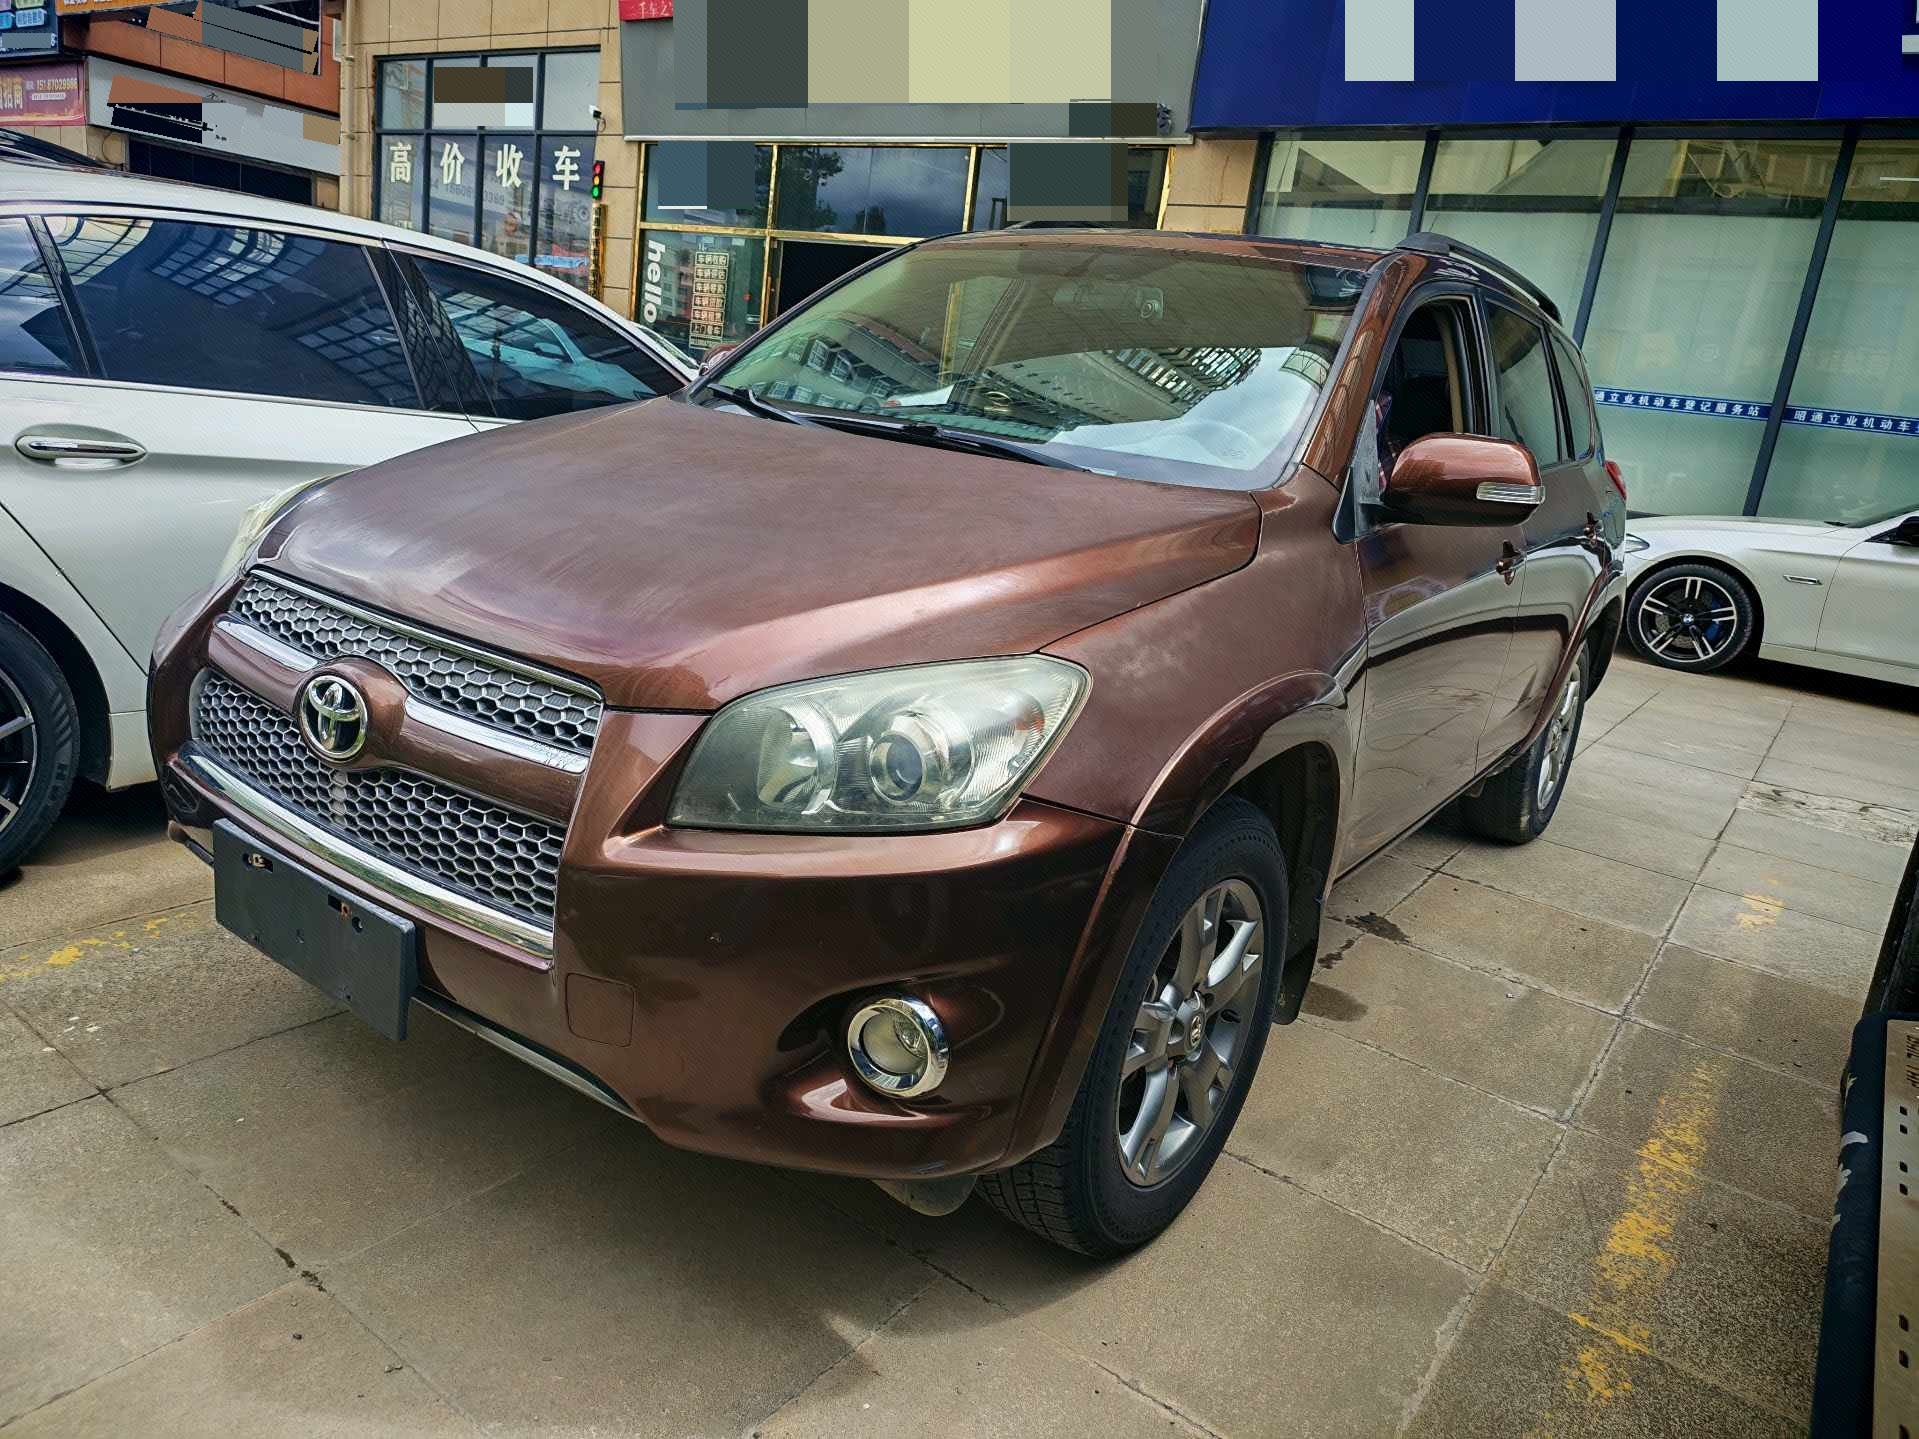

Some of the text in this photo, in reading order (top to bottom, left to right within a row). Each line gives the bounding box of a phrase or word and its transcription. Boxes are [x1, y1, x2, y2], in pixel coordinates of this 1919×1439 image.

[390, 142, 580, 191] 高价收车
[644, 240, 666, 323] hello
[1594, 390, 1760, 416] 通立业机动车登记服务站
